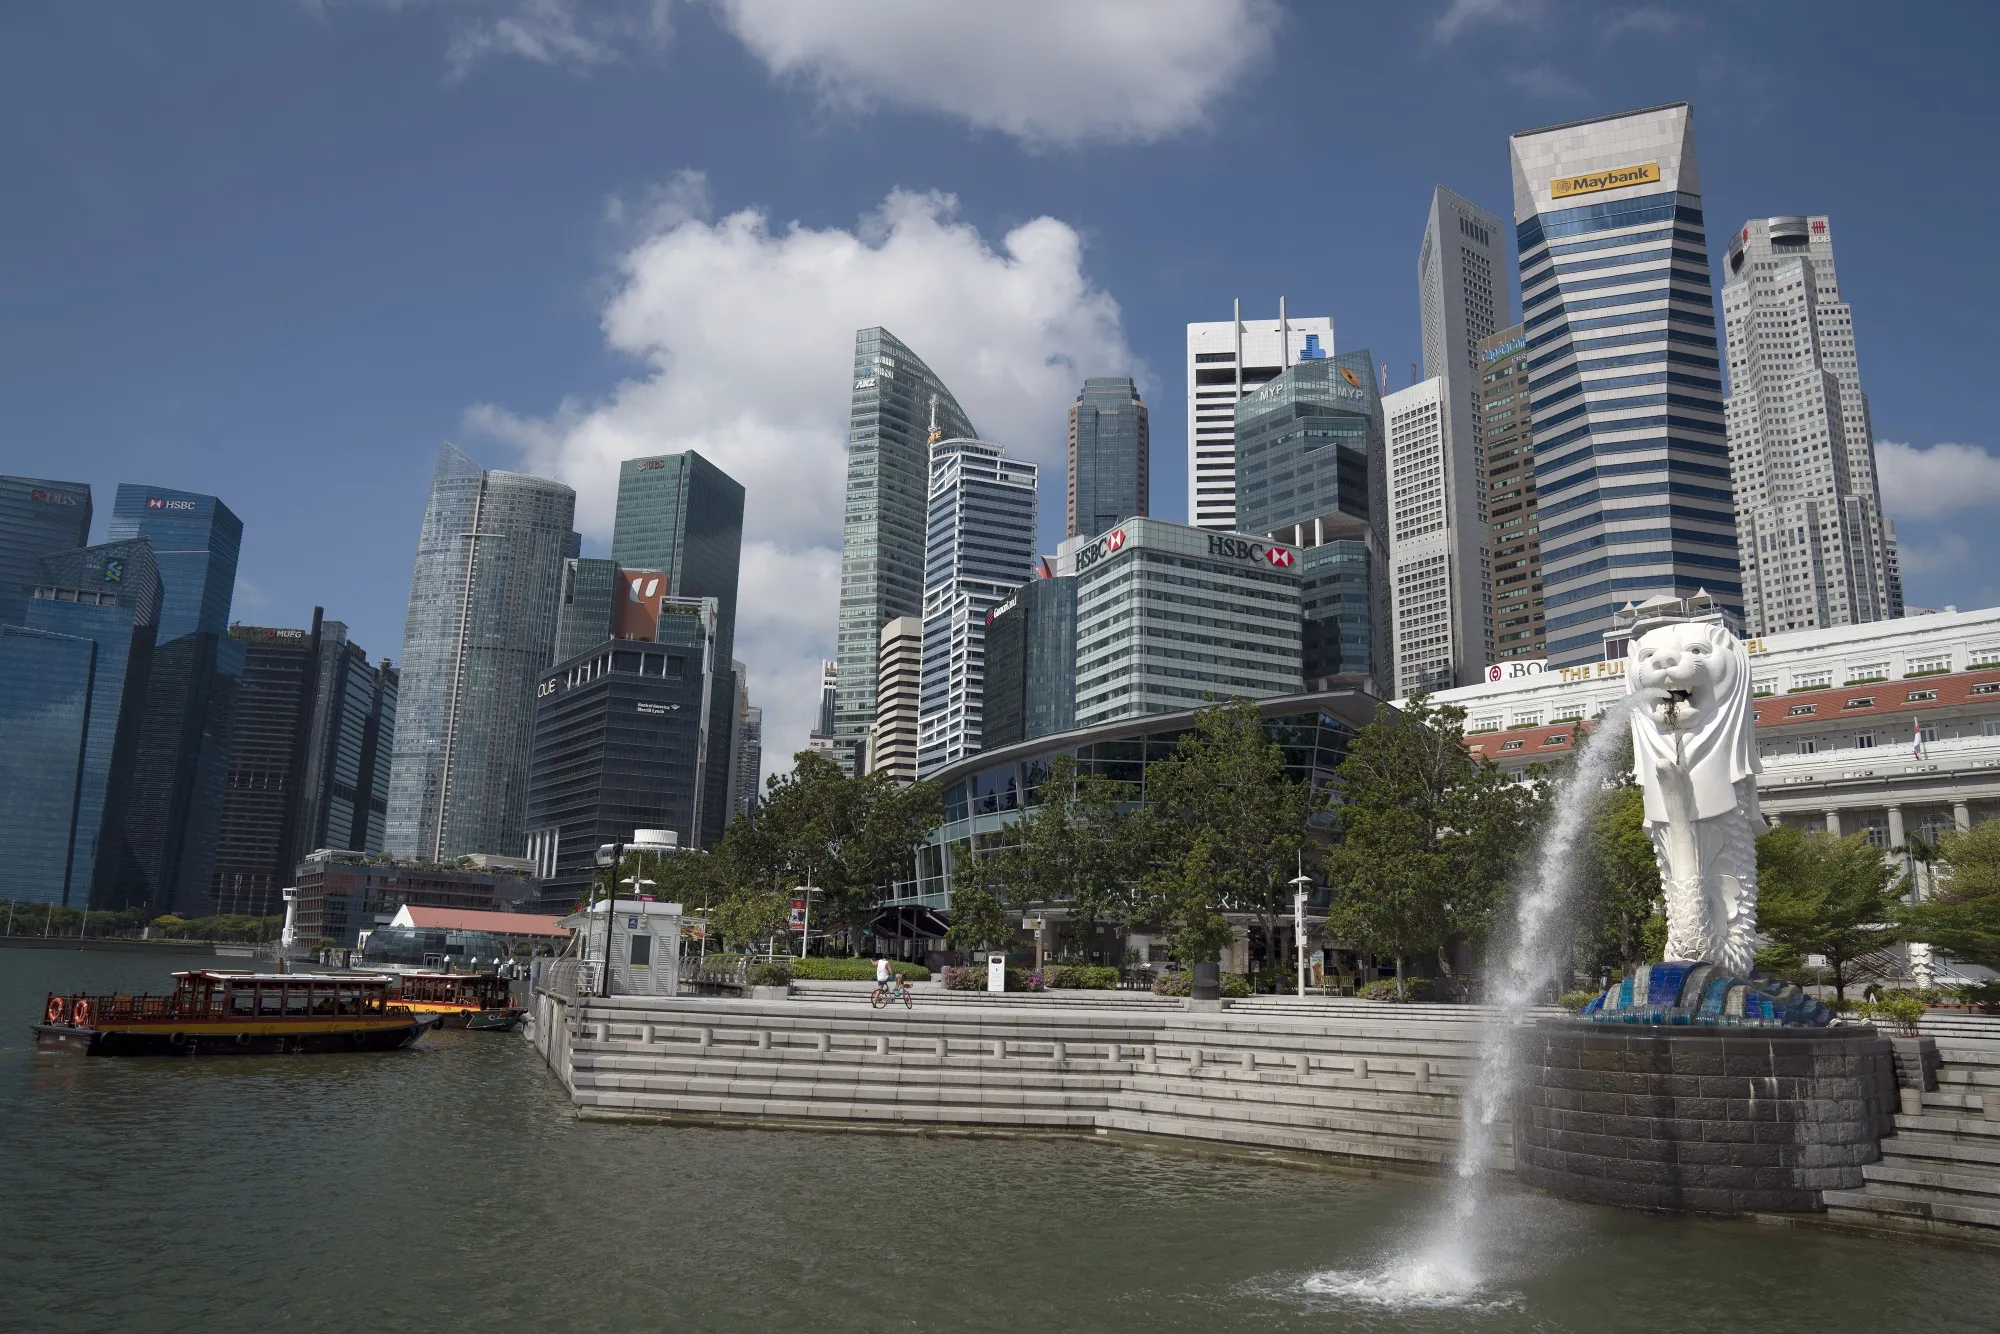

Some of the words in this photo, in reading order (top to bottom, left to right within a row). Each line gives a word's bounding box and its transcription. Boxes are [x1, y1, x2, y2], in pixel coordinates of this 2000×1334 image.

[1573, 167, 1649, 190] Maybank
[1809, 235, 1831, 243] UOB
[1260, 383, 1283, 401] MYP
[1337, 386, 1363, 400] MYP
[47, 492, 76, 506] DBS
[165, 500, 196, 510] HSBC
[1075, 537, 1107, 572] HSBC
[1207, 535, 1264, 562] HSBC
[276, 630, 302, 638] MUFG
[1510, 661, 1548, 678] BO
[1560, 665, 1590, 681] THE
